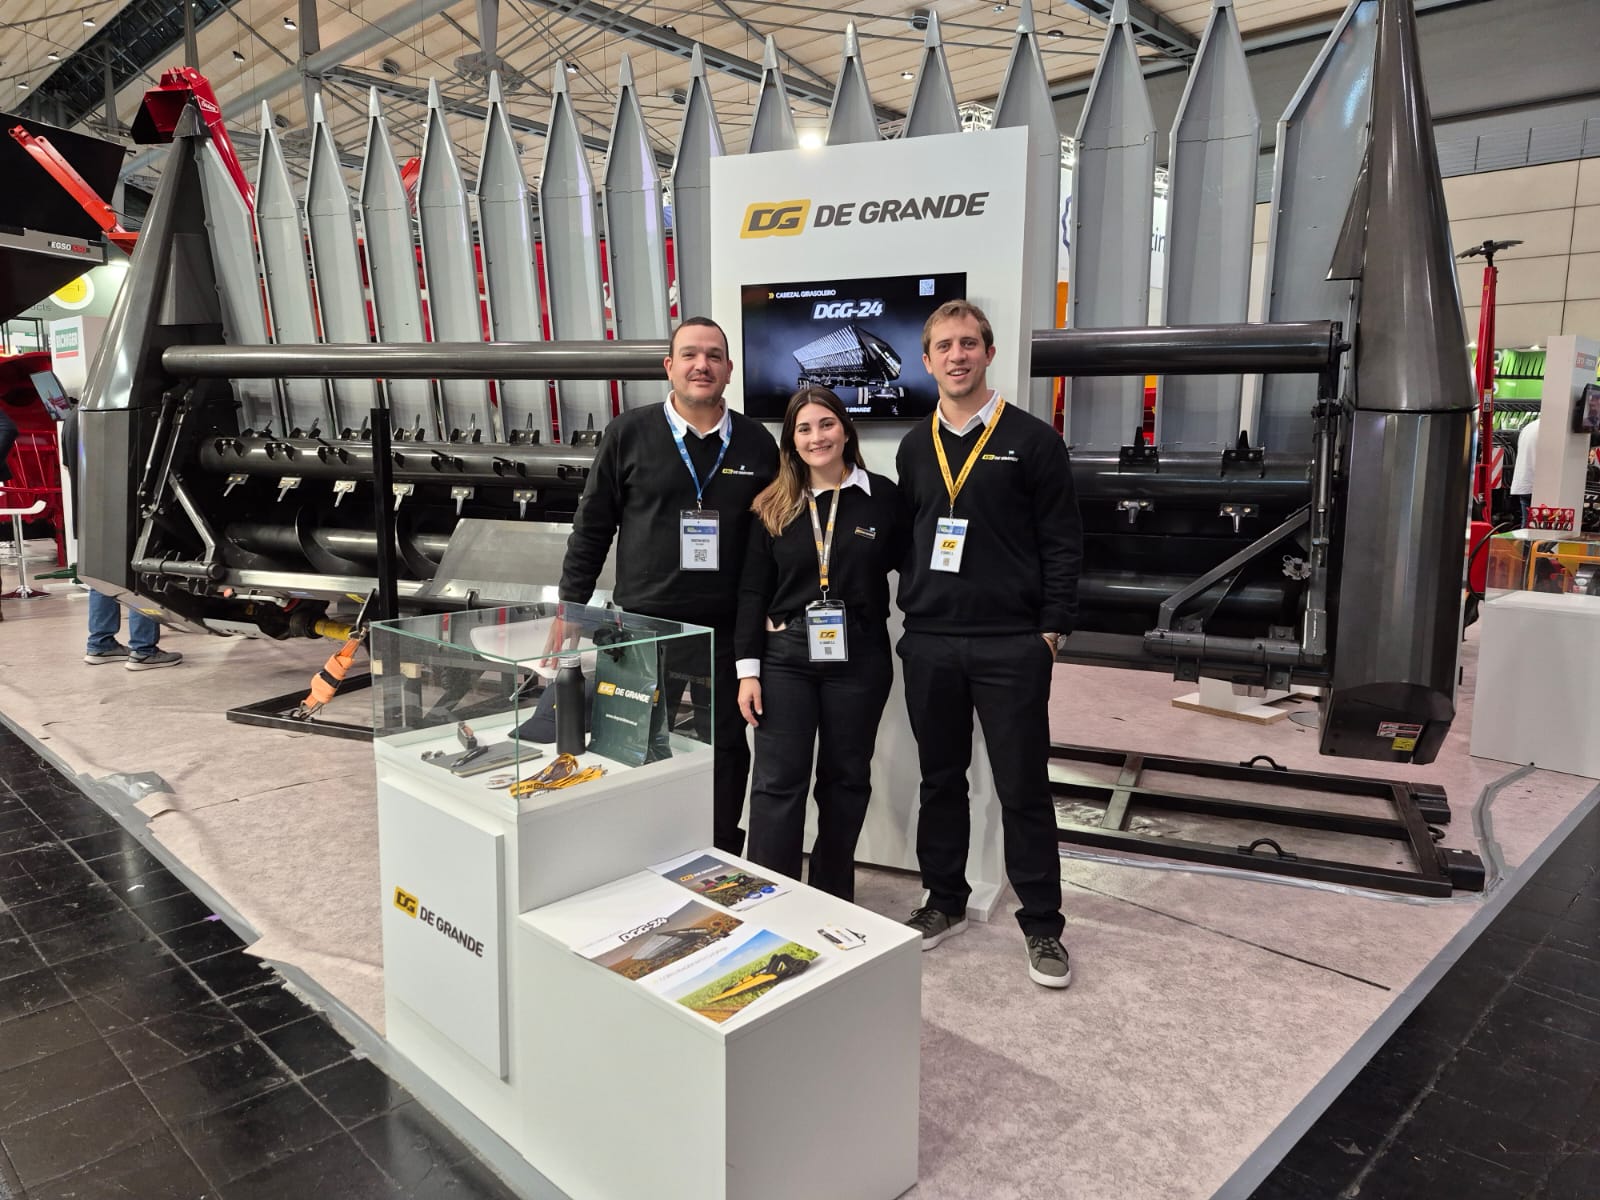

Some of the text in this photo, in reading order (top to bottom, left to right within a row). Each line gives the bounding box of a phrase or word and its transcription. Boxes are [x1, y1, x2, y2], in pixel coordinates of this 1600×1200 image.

[745, 191, 990, 234] DG DE GRANDE
[812, 300, 883, 320] DGG-24
[818, 630, 837, 639] DG
[615, 687, 625, 697] DE
[624, 689, 651, 704] GRANDE
[395, 890, 485, 958] DG DE GRANDE
[618, 916, 669, 943] DGG-24
